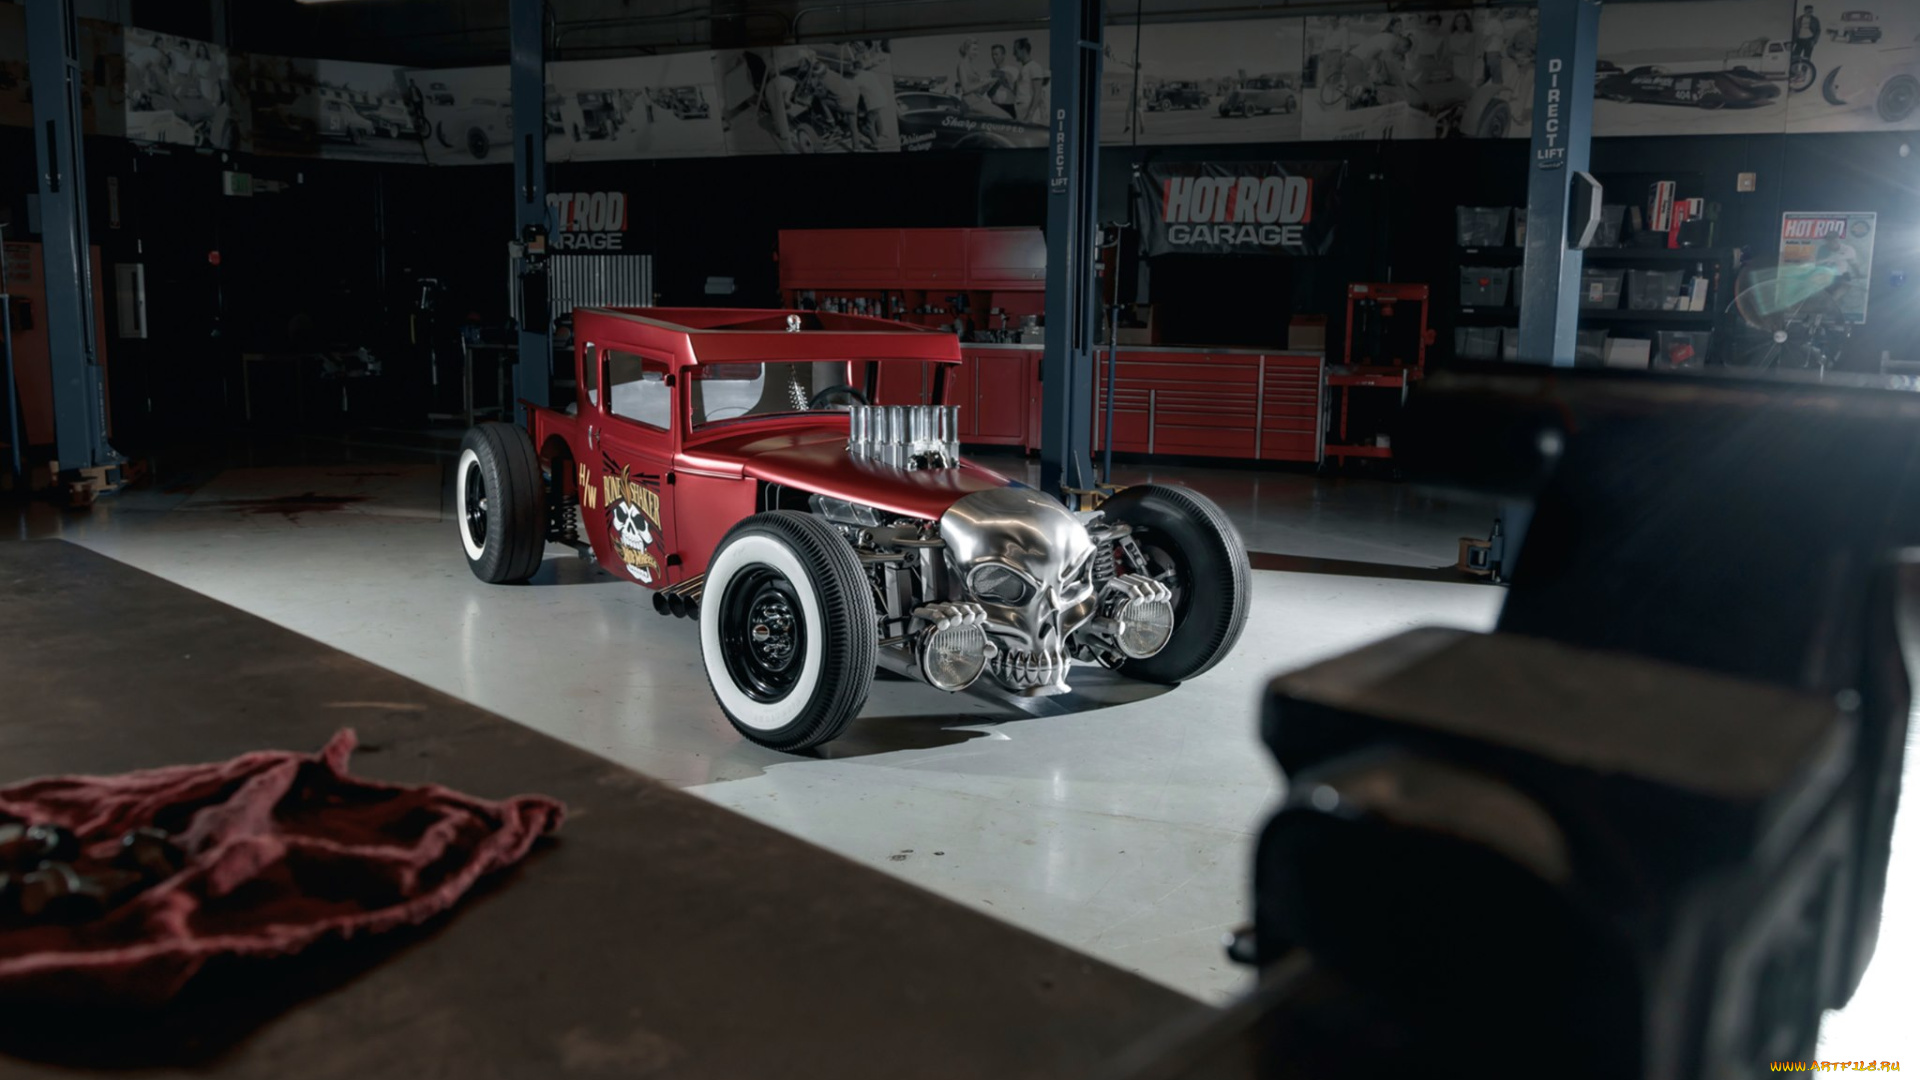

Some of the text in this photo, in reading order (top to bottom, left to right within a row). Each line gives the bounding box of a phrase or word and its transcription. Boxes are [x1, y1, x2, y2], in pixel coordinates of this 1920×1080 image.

[1546, 58, 1563, 148] DIRECT
[941, 115, 977, 131] Sharp
[1055, 108, 1066, 177] DIRECT
[1537, 148, 1565, 160] LIFT
[1051, 177, 1068, 187] LIFT
[1165, 176, 1308, 223] HOT ROD
[572, 191, 624, 232] ROD
[1168, 224, 1304, 246] GARAGE
[1784, 220, 1816, 238] HOT
[551, 232, 623, 250] RAGE
[630, 481, 662, 531] SHAKER
